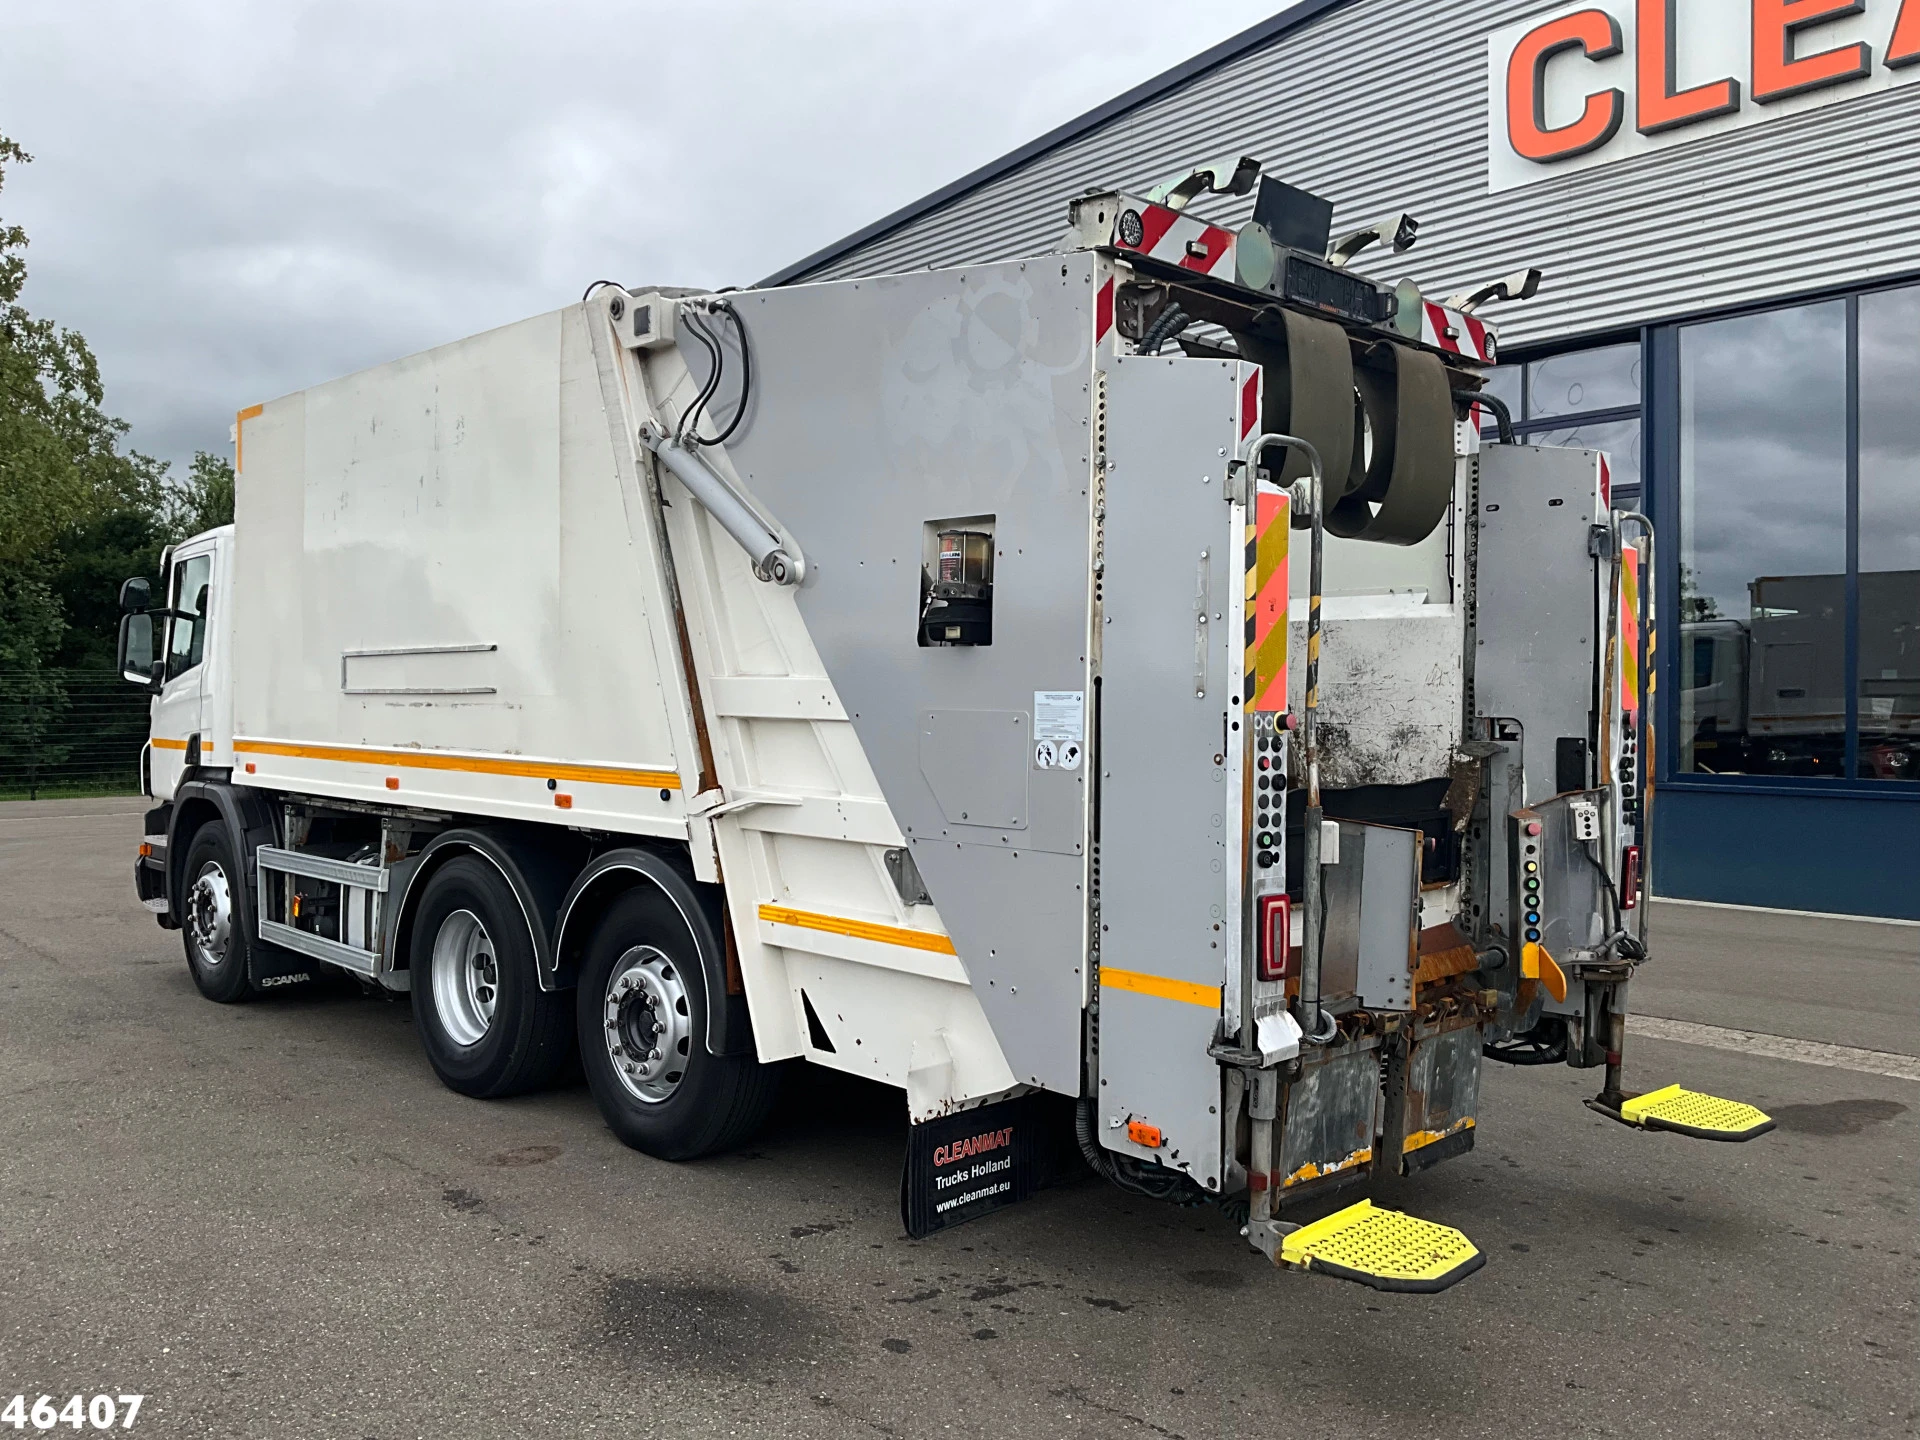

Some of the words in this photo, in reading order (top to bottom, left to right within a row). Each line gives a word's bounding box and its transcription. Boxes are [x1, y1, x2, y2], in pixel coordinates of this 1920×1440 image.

[1506, 0, 1920, 164] CLE
[262, 973, 310, 987] SCANIA
[933, 1127, 1013, 1167] CLEANMAT
[936, 1170, 969, 1190] Trucks
[971, 1156, 1011, 1178] Holland
[936, 1182, 1011, 1213] www.cleanmat.eu
